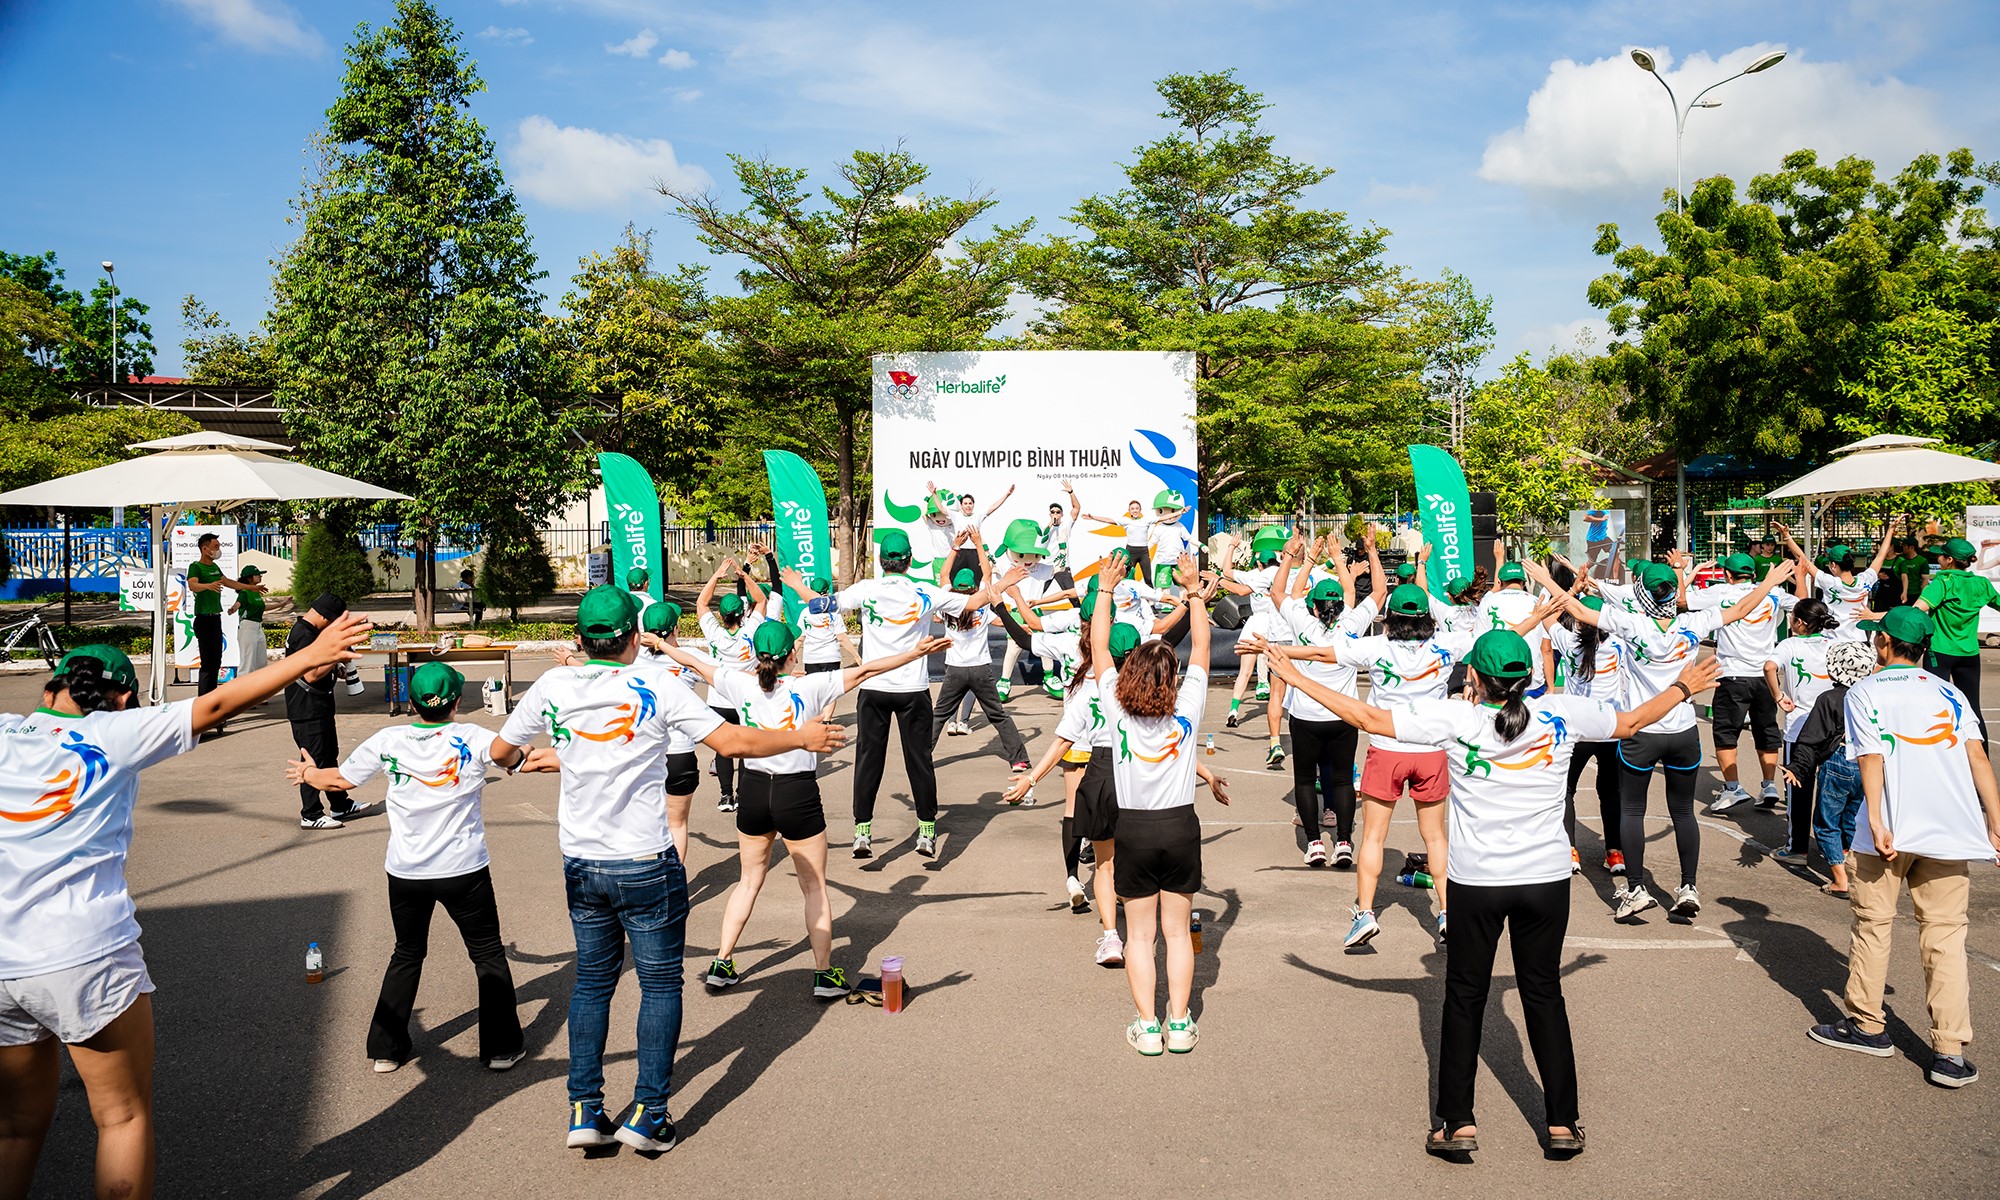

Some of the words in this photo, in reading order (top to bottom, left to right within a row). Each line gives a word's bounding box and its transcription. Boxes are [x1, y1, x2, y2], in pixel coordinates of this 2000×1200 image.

[936, 377, 1000, 394] Herbalife
[909, 448, 950, 469] NGÀY
[954, 449, 1022, 469] OLYMPIC
[1027, 446, 1065, 468] BÌNH
[1069, 446, 1121, 470] THUẬN
[1973, 519, 1985, 528] Sự
[132, 579, 147, 589] LỐI
